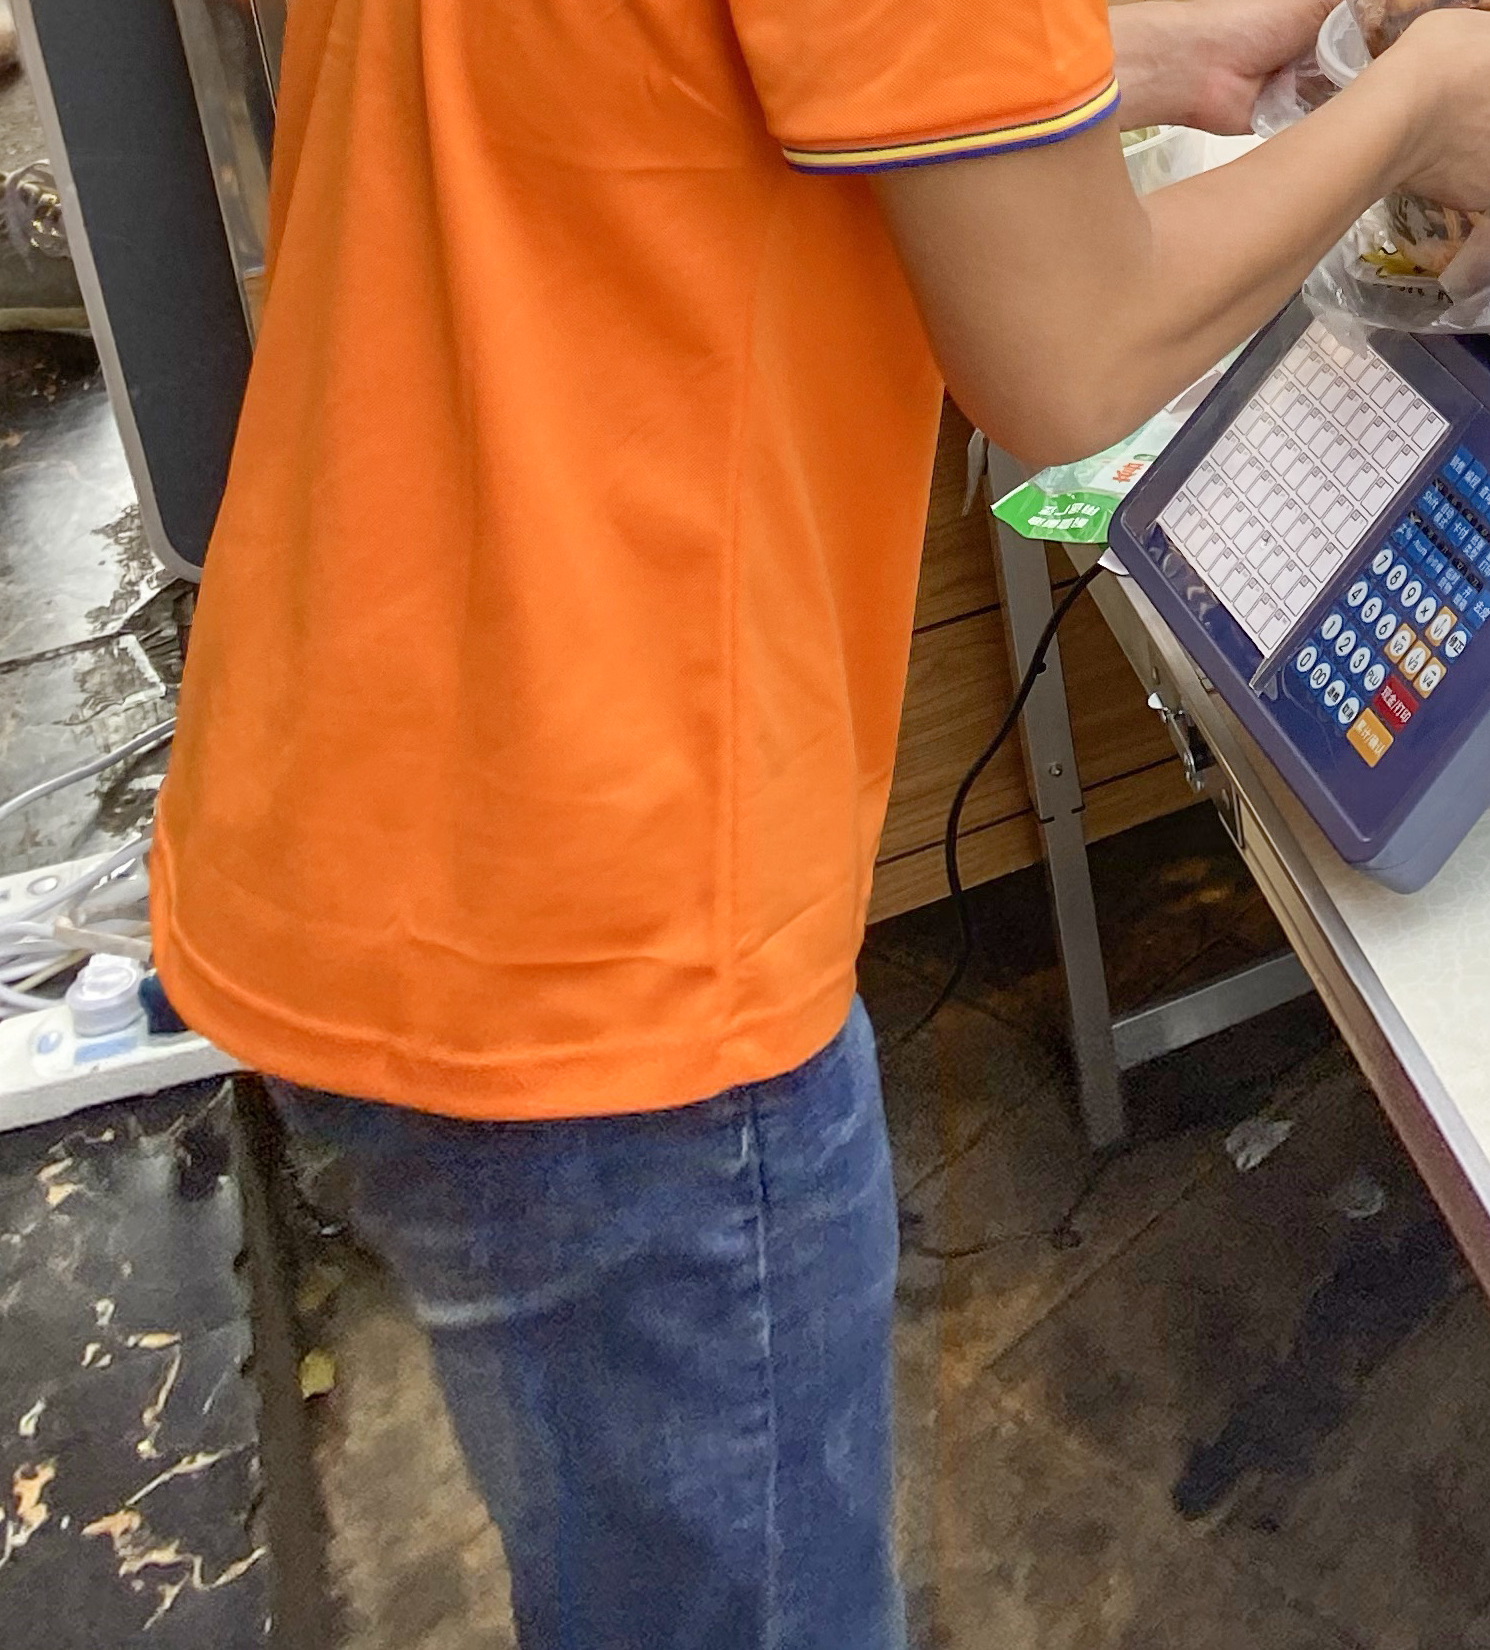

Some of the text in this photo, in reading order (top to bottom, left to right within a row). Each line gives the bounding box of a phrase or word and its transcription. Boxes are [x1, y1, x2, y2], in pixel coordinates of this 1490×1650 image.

[1376, 554, 1388, 567] 7
[1389, 570, 1401, 585] 8
[1351, 588, 1362, 601] 4
[1404, 586, 1416, 600] 9
[1364, 603, 1376, 618] 5
[1326, 620, 1335, 634] 1
[1378, 621, 1390, 635] 6
[1338, 636, 1350, 652] 2
[1392, 640, 1403, 653] V2
[1299, 652, 1311, 667] 0
[1353, 653, 1364, 668] 3
[1407, 656, 1418, 670] V3
[1364, 669, 1379, 686] PLU
[1422, 675, 1433, 687] V4
[1381, 685, 1411, 722] 现金/打印
